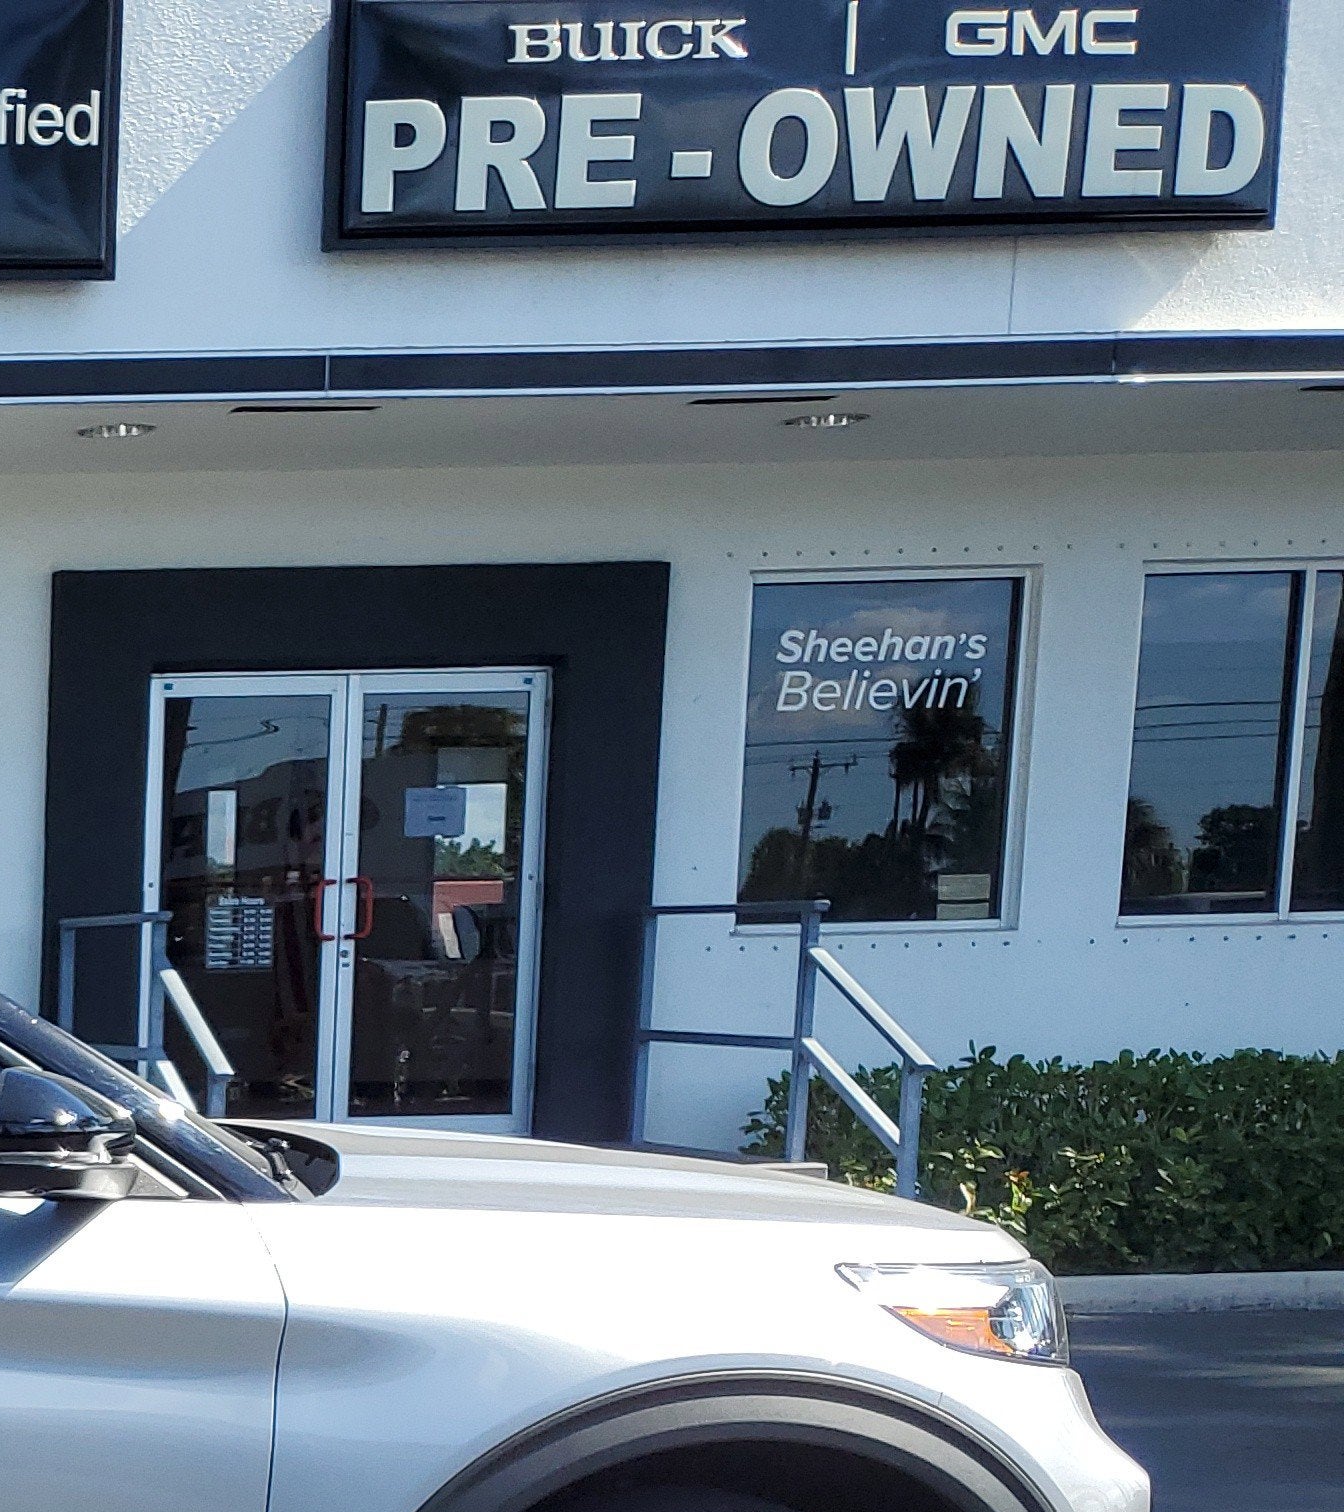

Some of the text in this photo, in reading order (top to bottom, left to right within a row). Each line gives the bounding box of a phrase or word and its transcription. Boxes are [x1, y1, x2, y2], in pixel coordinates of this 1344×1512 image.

[508, 18, 748, 63] BUICK
[945, 8, 1140, 56] GMC
[775, 628, 988, 663] Sheehan's
[775, 667, 983, 712] Believin'
